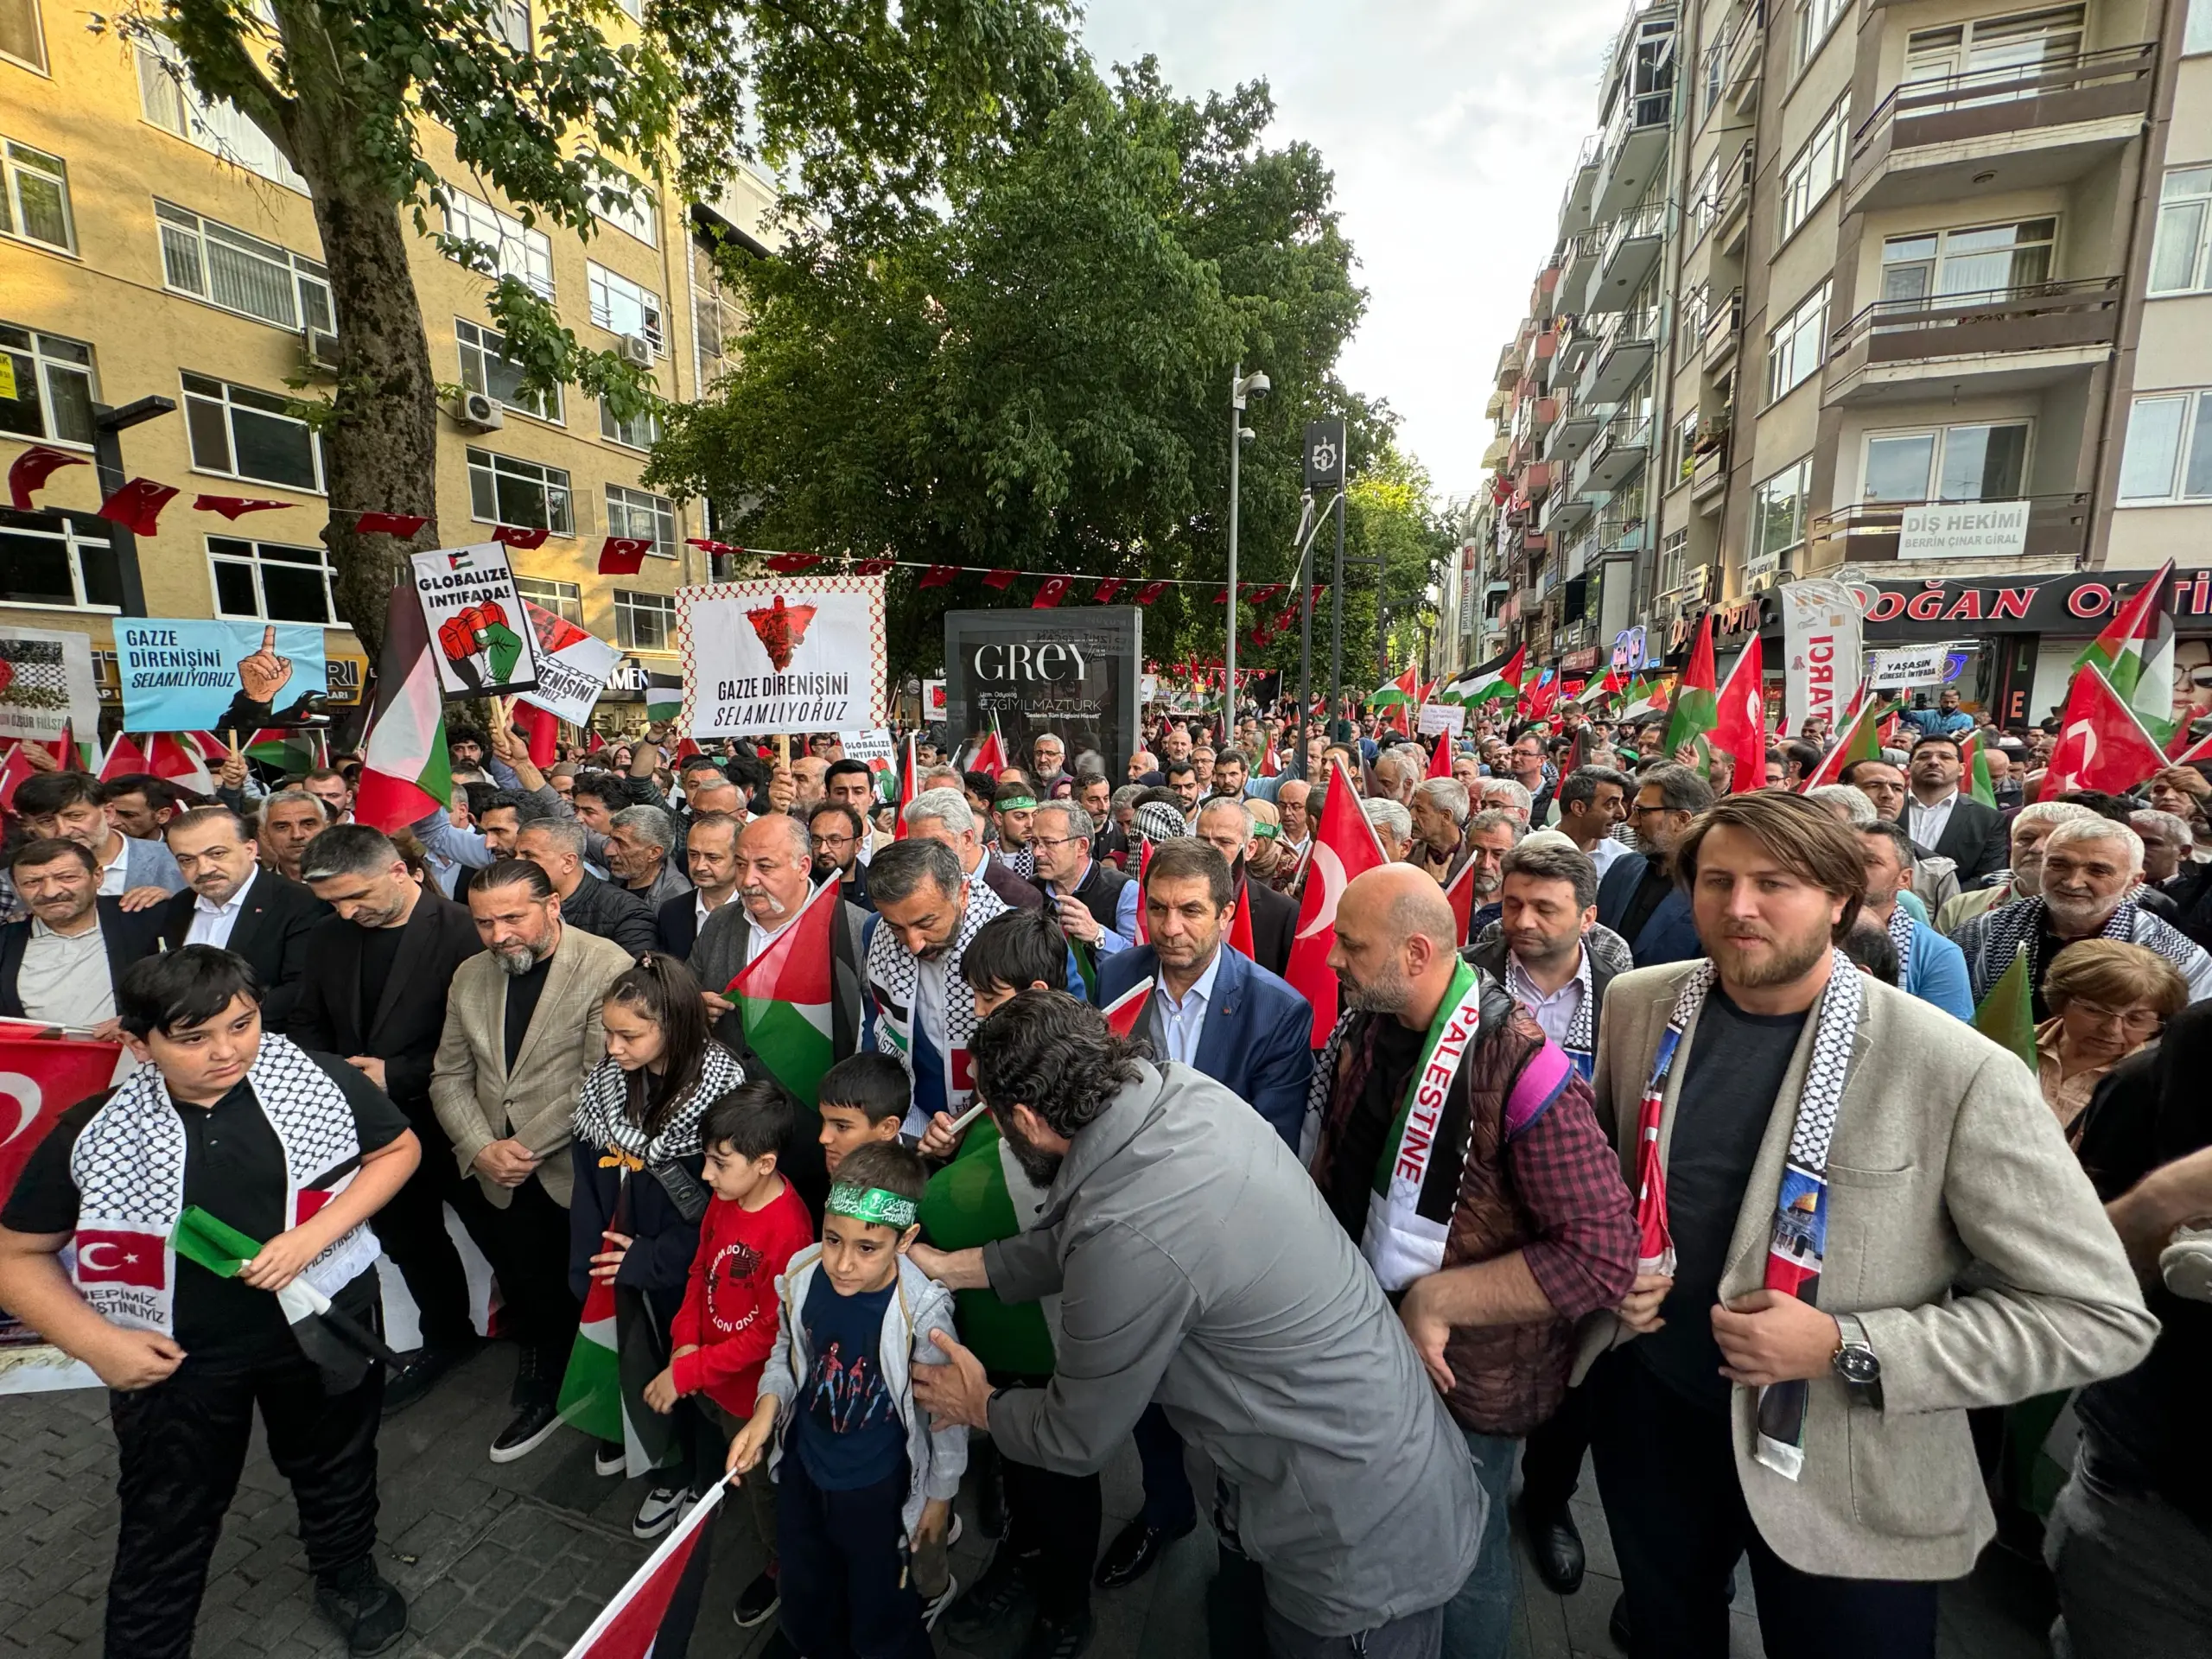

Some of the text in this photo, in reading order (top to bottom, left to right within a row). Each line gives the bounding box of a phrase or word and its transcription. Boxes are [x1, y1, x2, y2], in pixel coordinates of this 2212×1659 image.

[1907, 509, 2022, 535] DİŞ HEKİMİ
[1904, 532, 2018, 548] BERRİN ÇINAR GİRAL
[419, 567, 510, 591] GLOBALIZE
[429, 585, 511, 608] INTIFADA!
[126, 629, 177, 646] GAZZE
[130, 649, 221, 671] DİRENİŞİNİ
[1887, 659, 1931, 671] YAŞASIN
[131, 670, 236, 688] SELAMLIYORUZ
[536, 660, 597, 703] RENİŞİNİ
[1879, 667, 1936, 680] KÜRESEL İNTİFADA
[718, 672, 849, 702] GAZZE DİRENİŞİNİ
[714, 701, 849, 727] SELAMLIYORUZ
[845, 741, 890, 749] GLOBALIZE
[849, 750, 891, 759] INTIFADA!
[1396, 1005, 1479, 1184] PALESTINE
